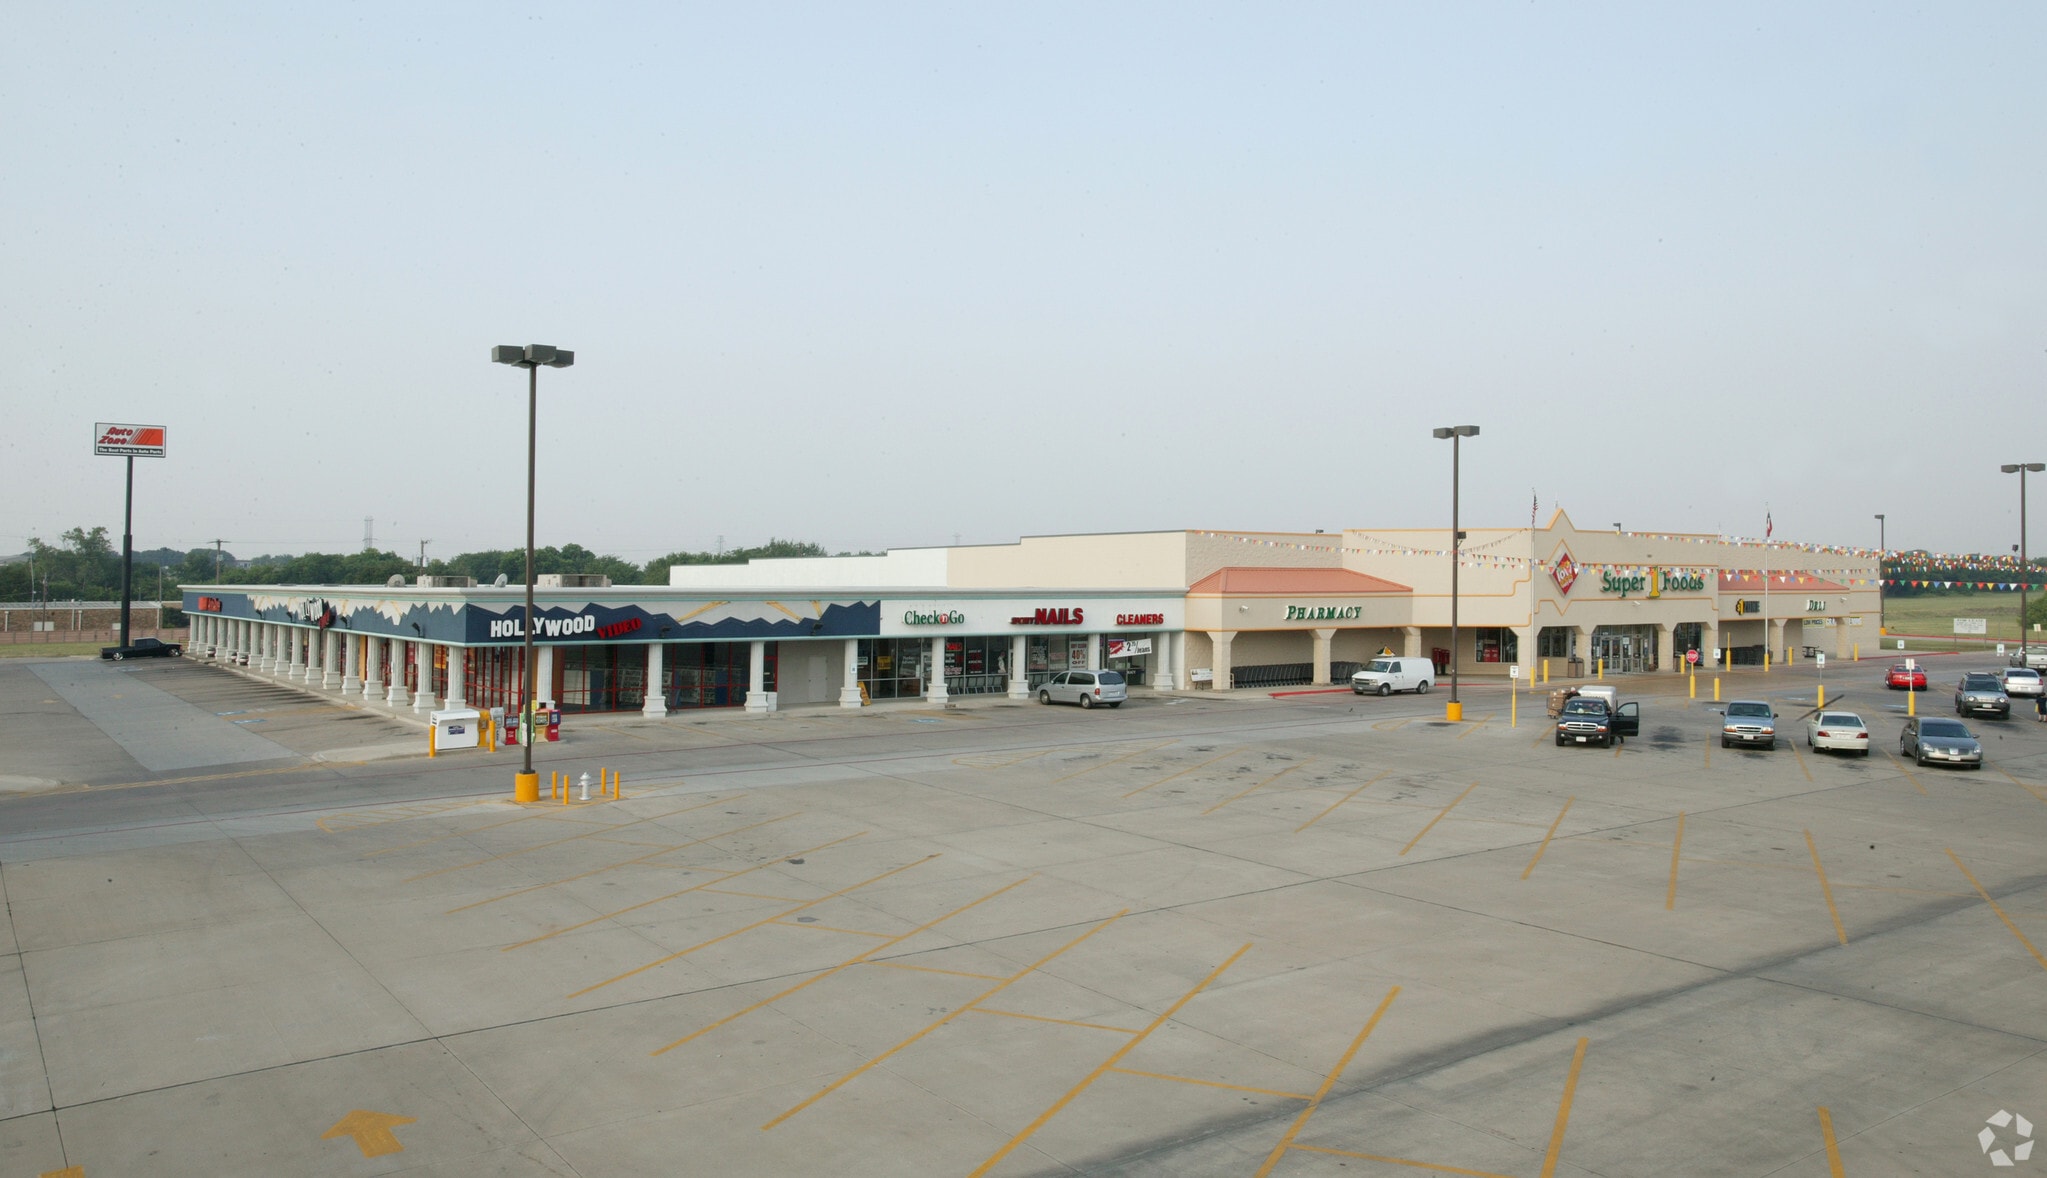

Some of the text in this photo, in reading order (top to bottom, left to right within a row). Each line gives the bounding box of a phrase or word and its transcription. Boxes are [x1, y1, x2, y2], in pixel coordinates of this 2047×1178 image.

[107, 426, 133, 436] Auto
[98, 435, 127, 445] Zone
[1602, 571, 1646, 597] Super
[1649, 566, 1661, 598] 1
[904, 610, 940, 625] Check
[949, 610, 965, 624] Go
[1035, 608, 1084, 625] NAILS
[1116, 613, 1164, 625] CLEANERS
[1284, 605, 1362, 620] PHARMACY
[490, 615, 595, 638] HOLYWOOD
[596, 617, 642, 639] VIDEO
